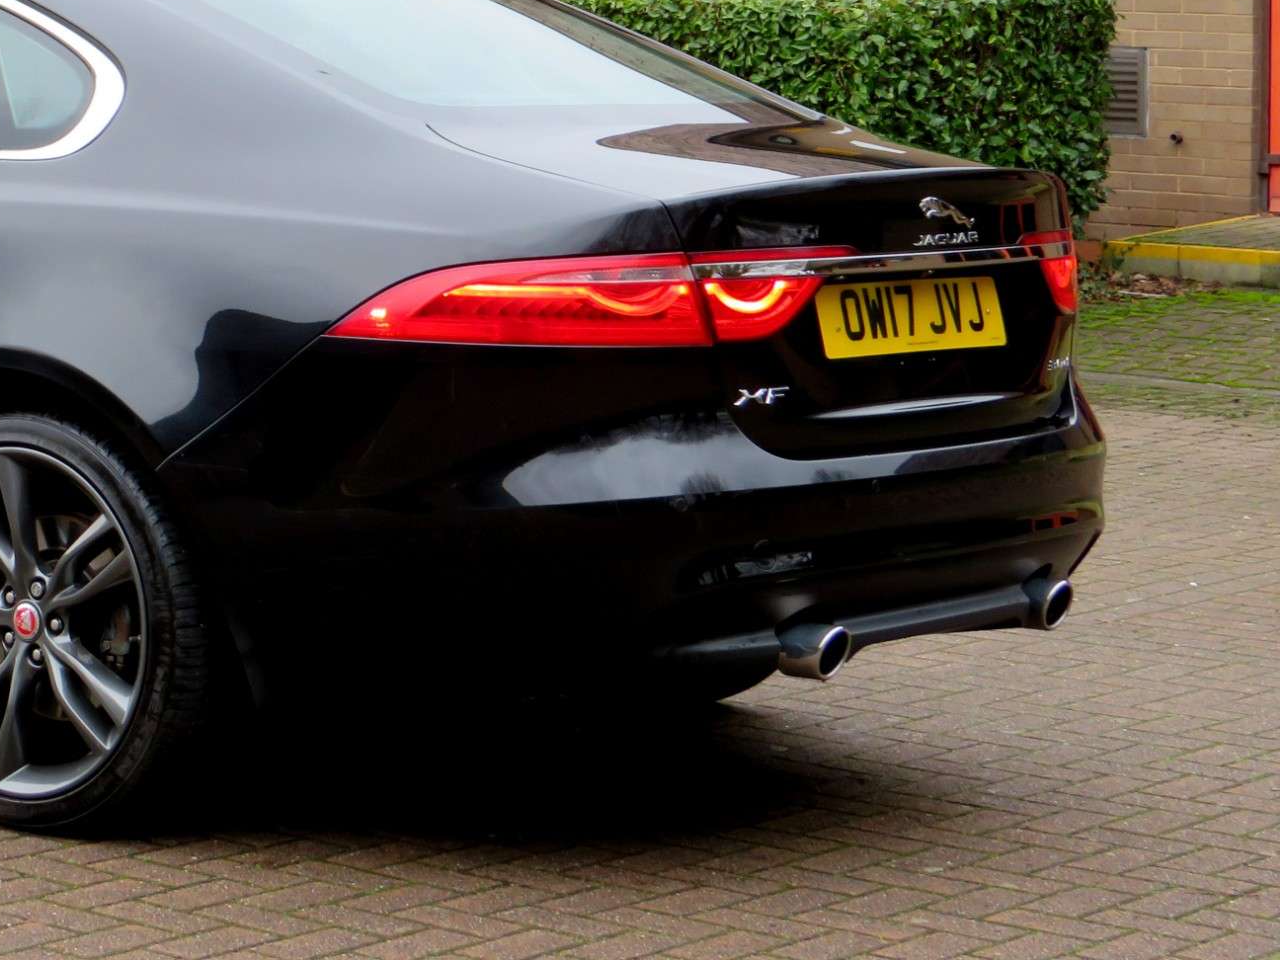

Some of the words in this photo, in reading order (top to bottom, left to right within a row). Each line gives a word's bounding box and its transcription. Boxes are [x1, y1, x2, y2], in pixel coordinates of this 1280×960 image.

[913, 230, 979, 246] JAGUAR
[840, 285, 915, 341] OW17
[929, 282, 984, 334] JVJ
[733, 386, 789, 406] XF
